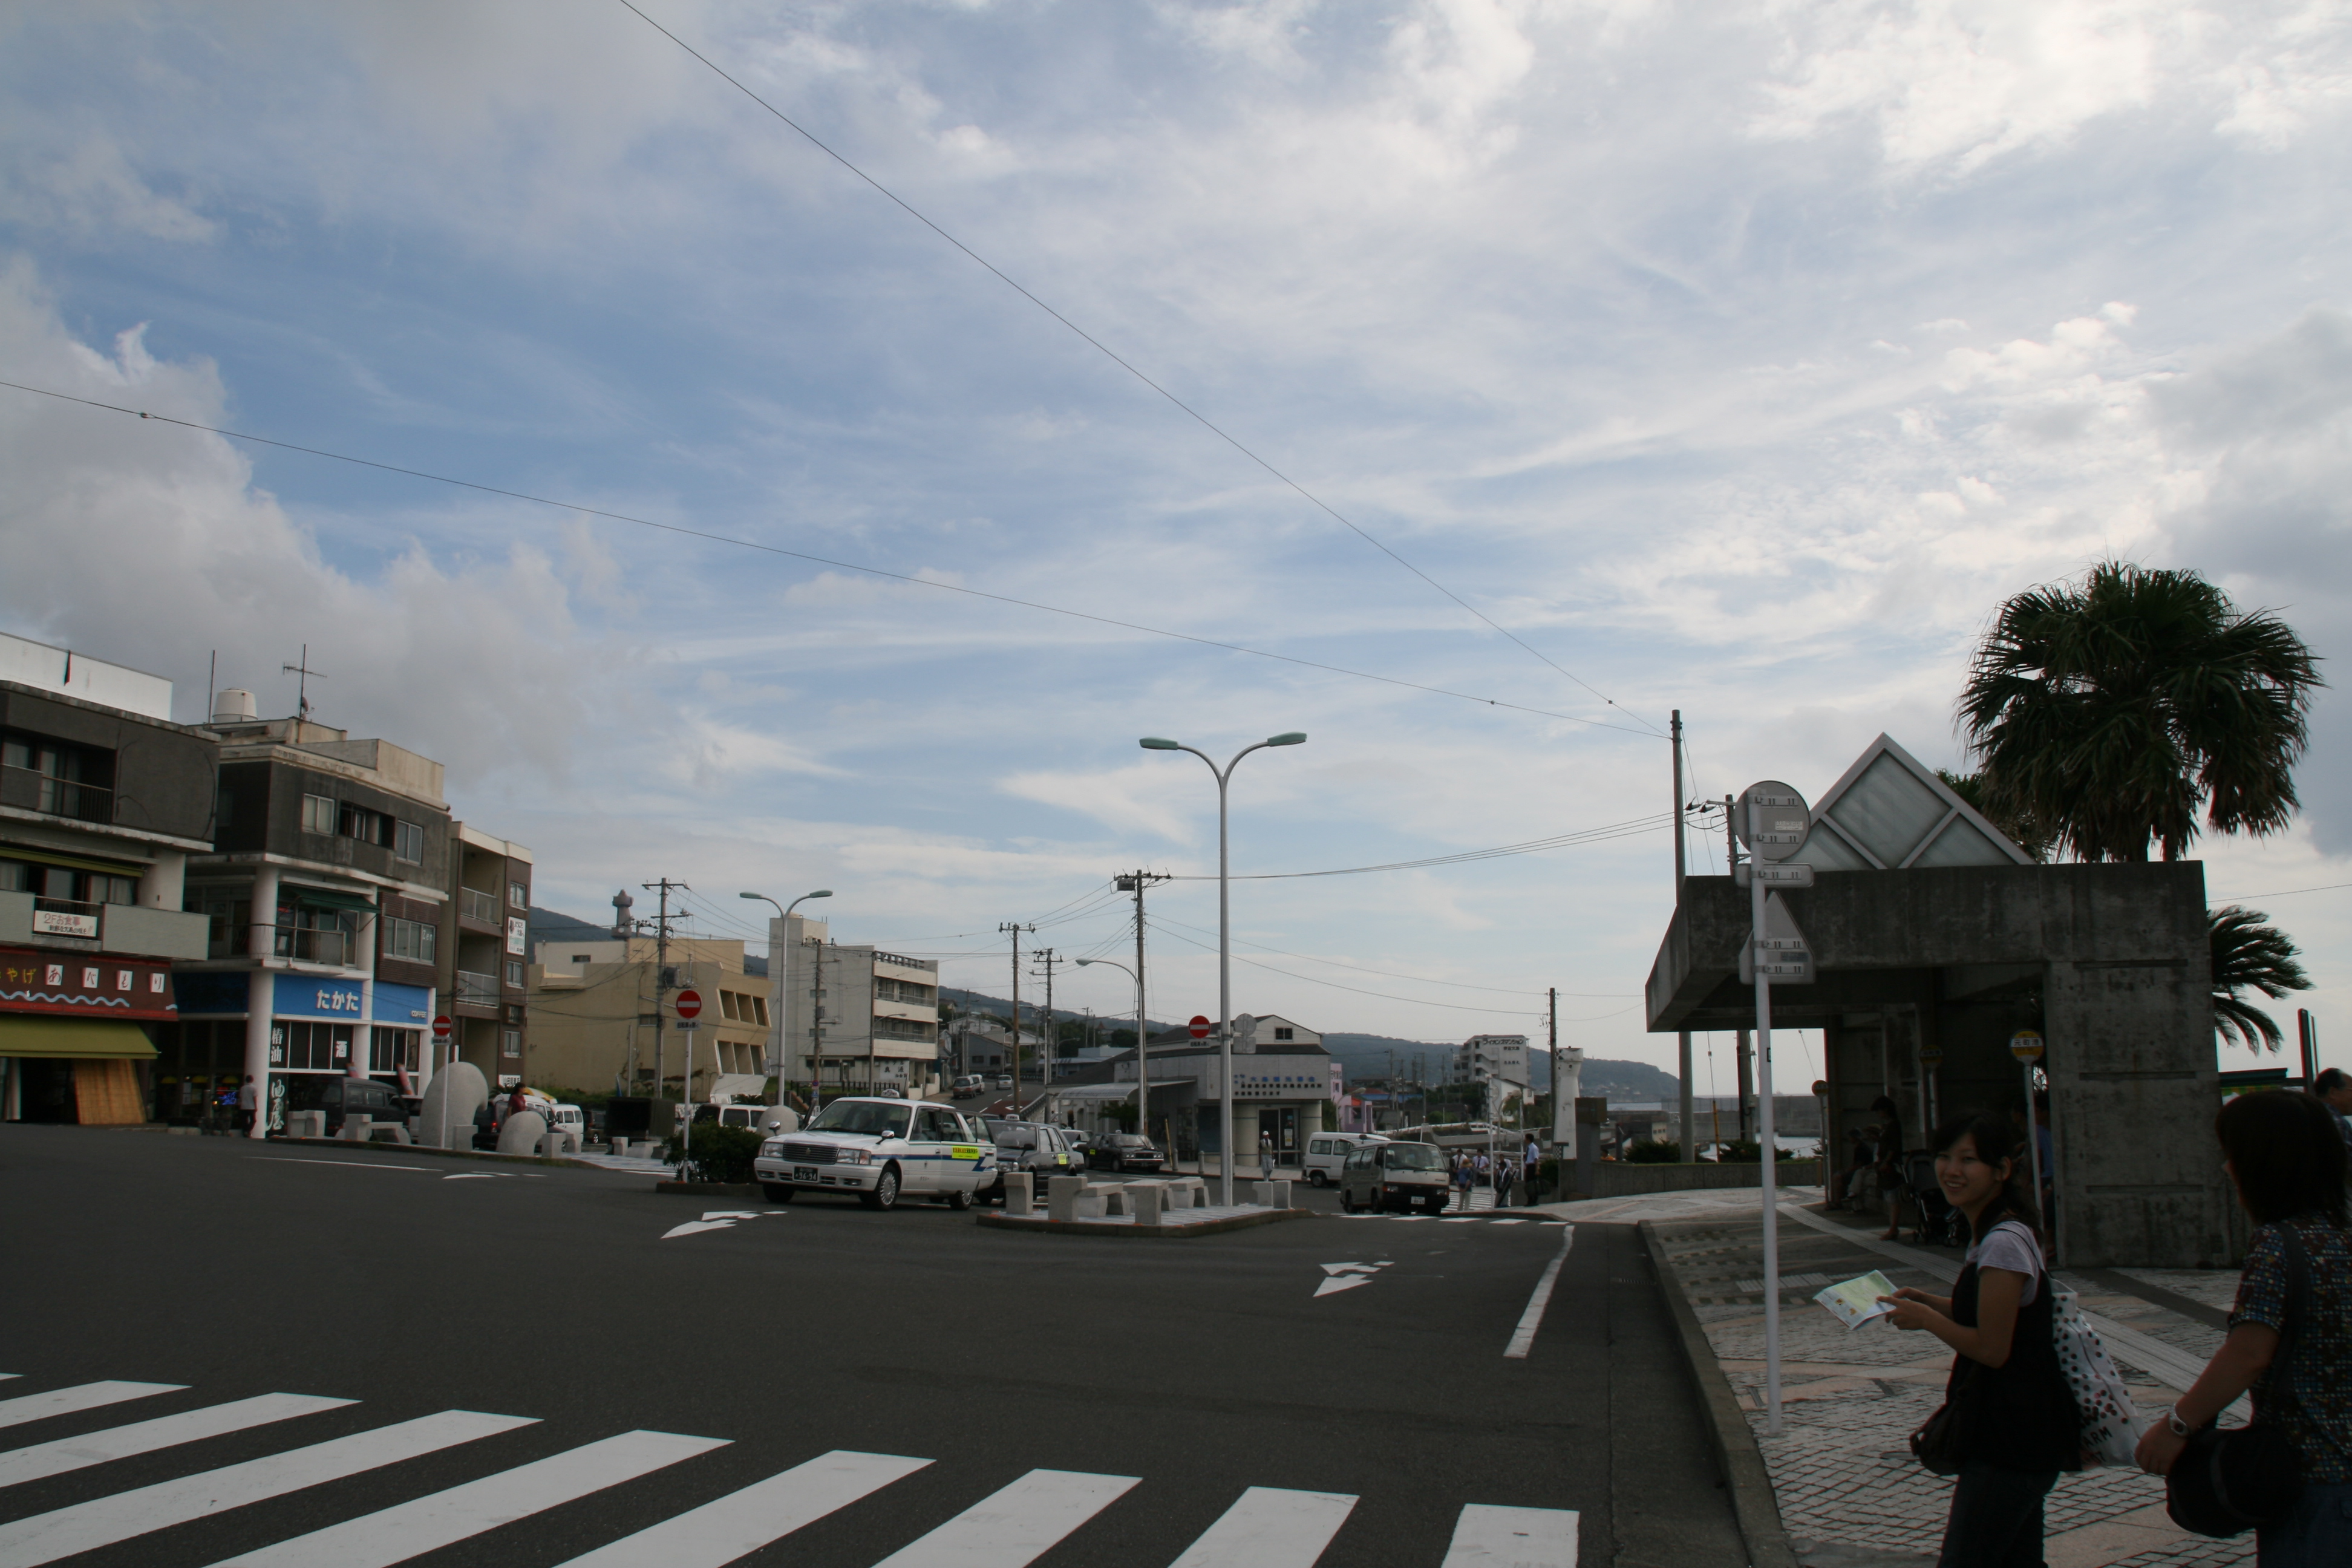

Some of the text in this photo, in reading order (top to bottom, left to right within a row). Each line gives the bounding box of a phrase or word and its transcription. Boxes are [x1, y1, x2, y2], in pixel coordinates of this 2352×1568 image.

[0, 967, 38, 984] やげ
[316, 988, 359, 1013] たかた
[270, 1027, 284, 1063] 椿油
[335, 1040, 348, 1059] 酒
[799, 1171, 817, 1181] 96-94
[2080, 1426, 2113, 1449] ARM
